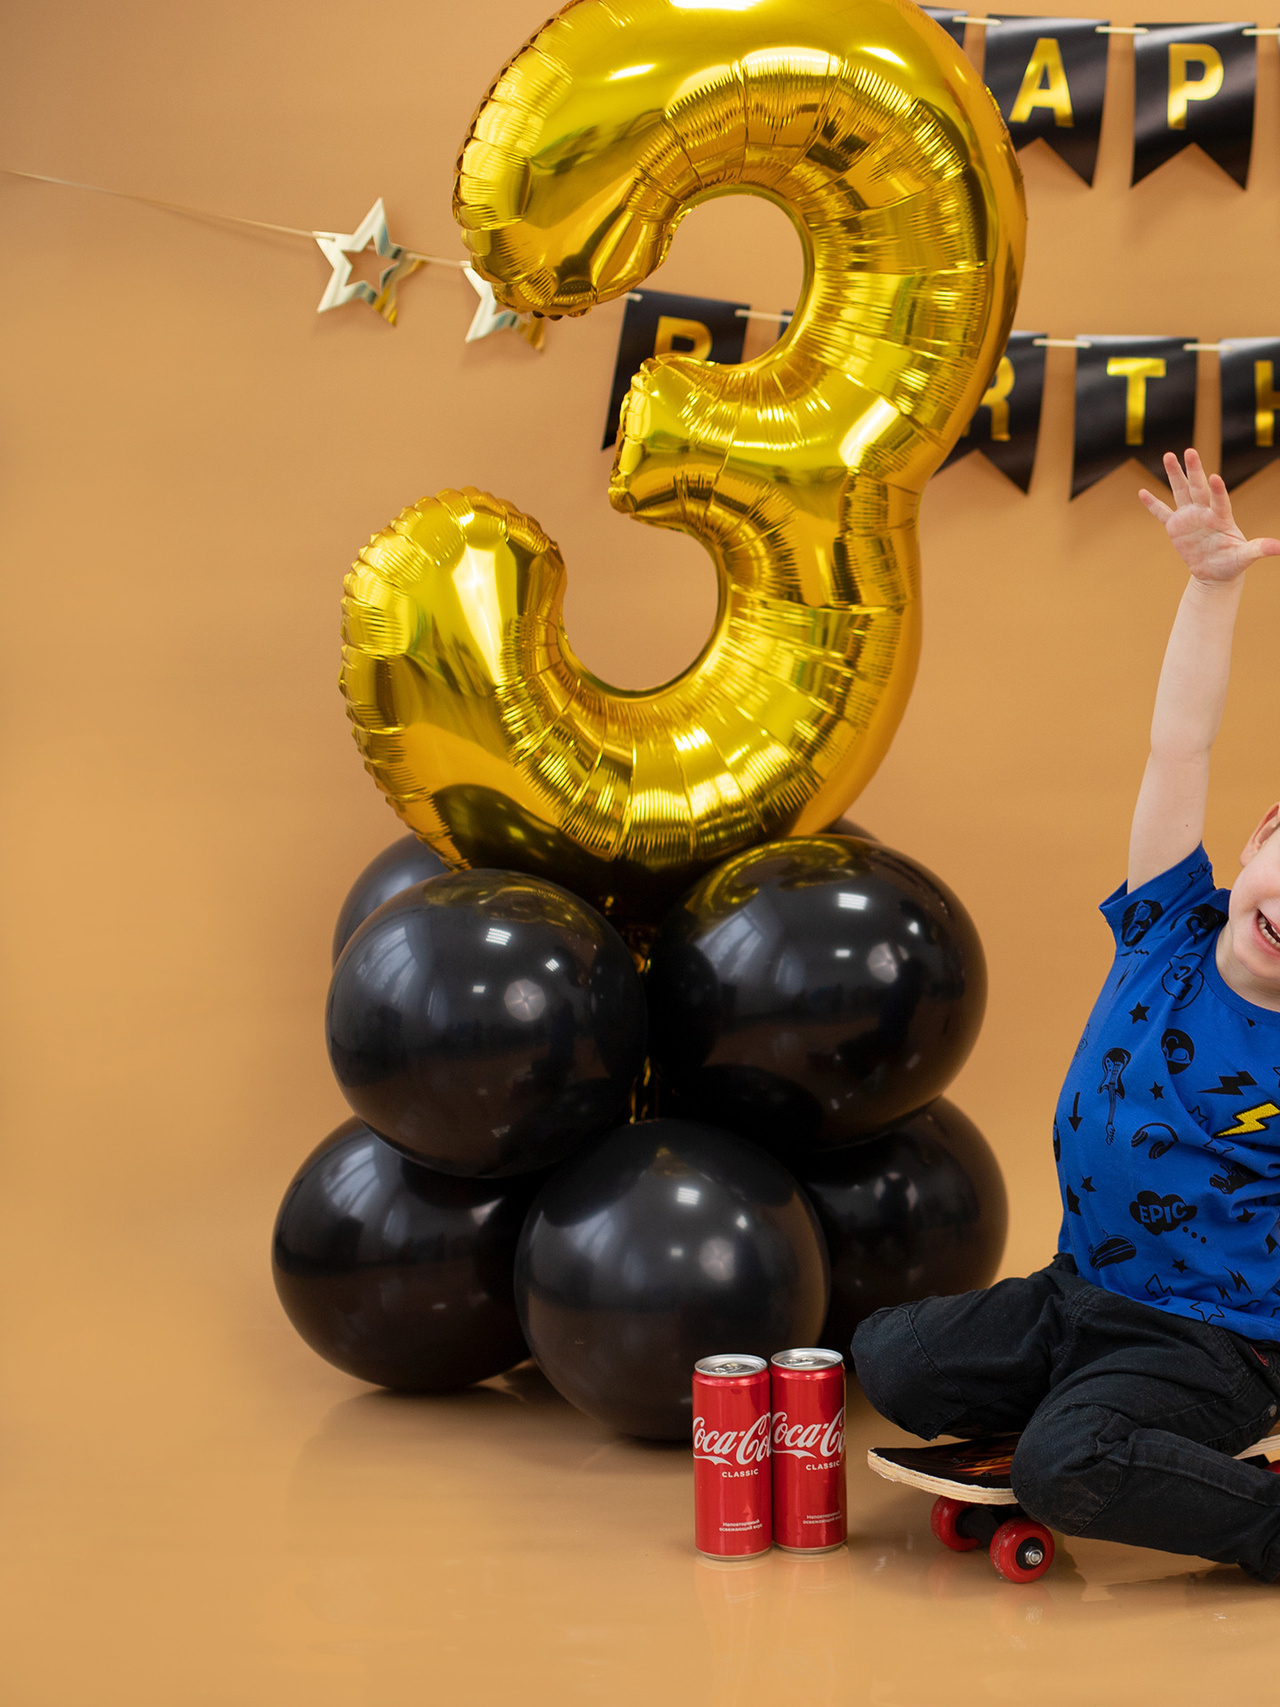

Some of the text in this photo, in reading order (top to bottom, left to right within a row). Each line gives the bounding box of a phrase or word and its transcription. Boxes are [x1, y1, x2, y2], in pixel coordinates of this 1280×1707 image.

[1139, 1201, 1188, 1224] EPIC
[692, 1411, 772, 1466] Coca-Col
[722, 1468, 759, 1478] CLASSIC
[805, 1460, 840, 1471] CLASSIC
